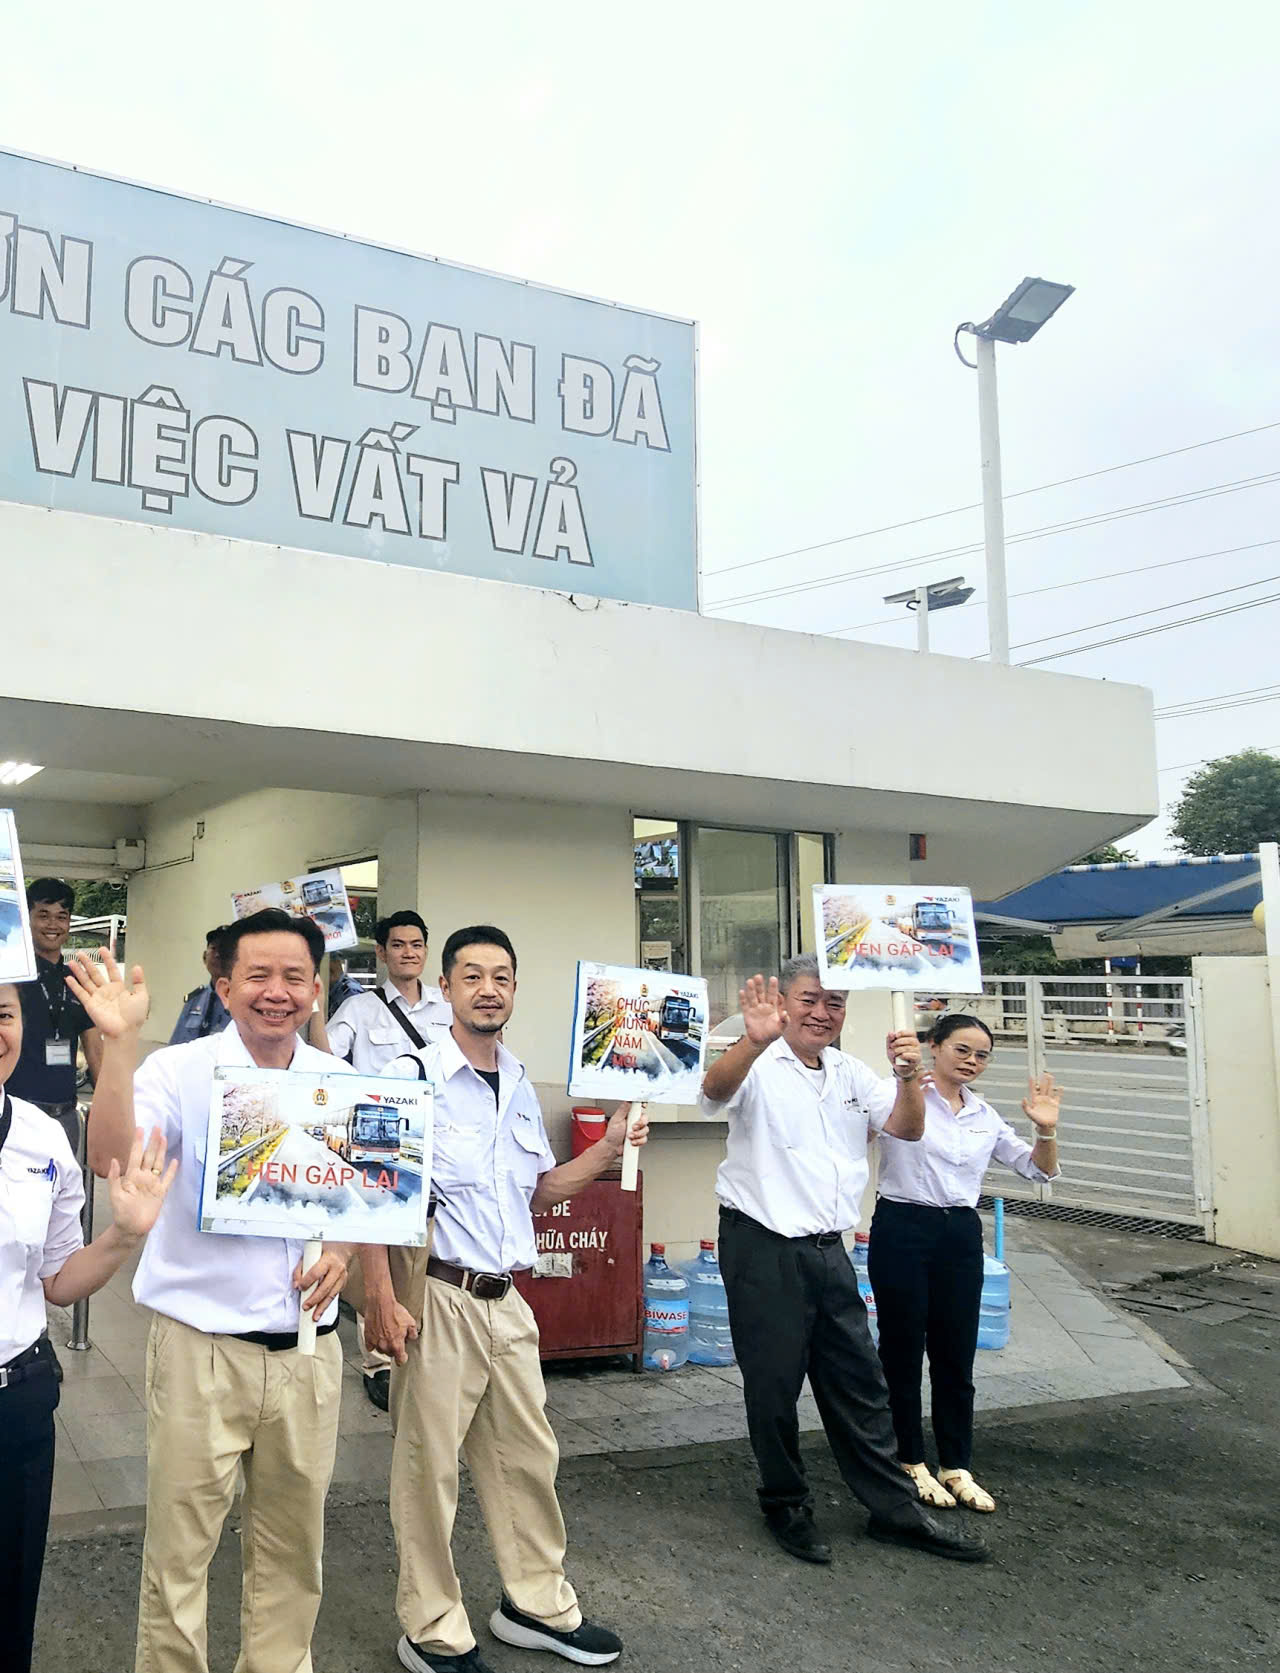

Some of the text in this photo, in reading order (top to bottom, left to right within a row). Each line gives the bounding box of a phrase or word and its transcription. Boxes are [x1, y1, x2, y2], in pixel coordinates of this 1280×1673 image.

[124, 255, 326, 375] CÁC
[353, 303, 536, 425] BẠN
[557, 352, 672, 453] ĐÃ
[21, 376, 260, 515] VIỆC
[285, 421, 460, 542] VẤT
[480, 456, 595, 568] VẢ
[616, 997, 651, 1013] CHÚC
[614, 1033, 643, 1050] NĂM
[383, 1096, 419, 1106] YAZAKI
[305, 1162, 355, 1190] GẶP
[362, 1168, 399, 1193] LẠI
[535, 1228, 566, 1250] HỮA
